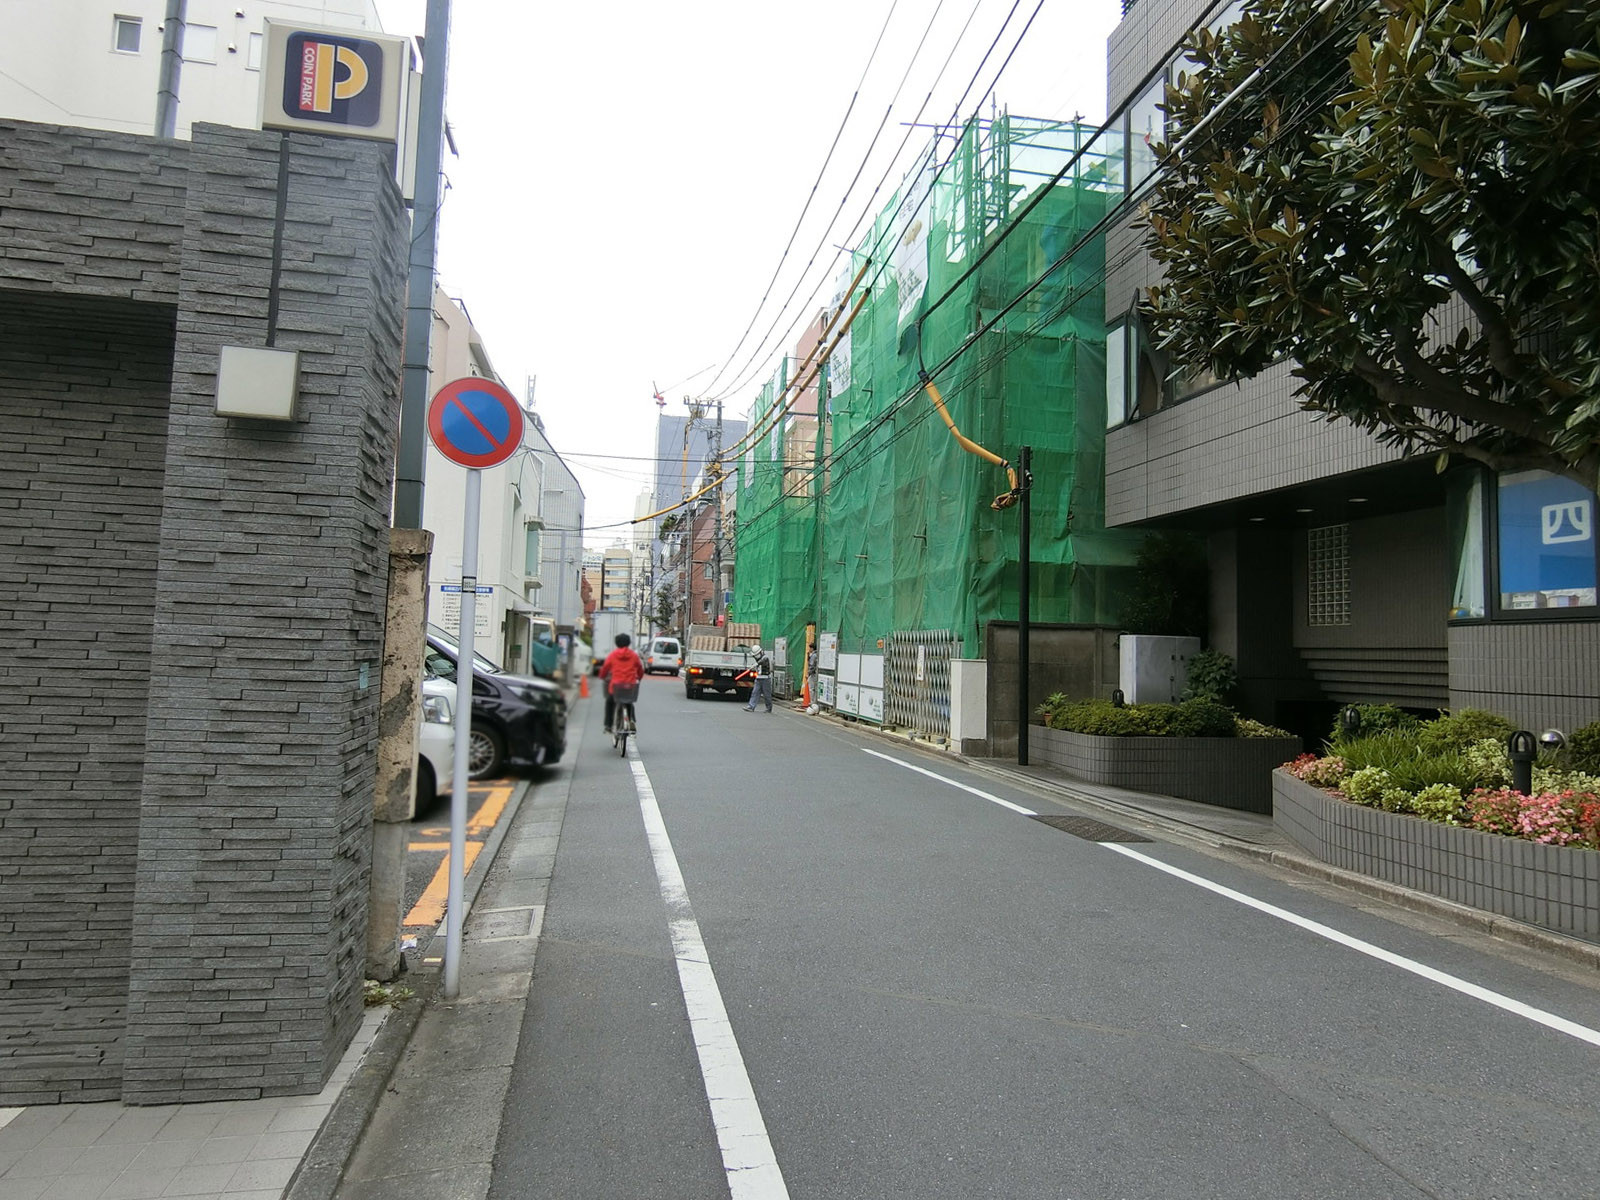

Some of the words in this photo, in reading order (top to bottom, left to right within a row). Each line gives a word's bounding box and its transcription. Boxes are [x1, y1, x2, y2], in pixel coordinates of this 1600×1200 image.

[303, 47, 315, 75] COIN
[301, 77, 313, 105] PARK
[1542, 500, 1591, 545] 四
